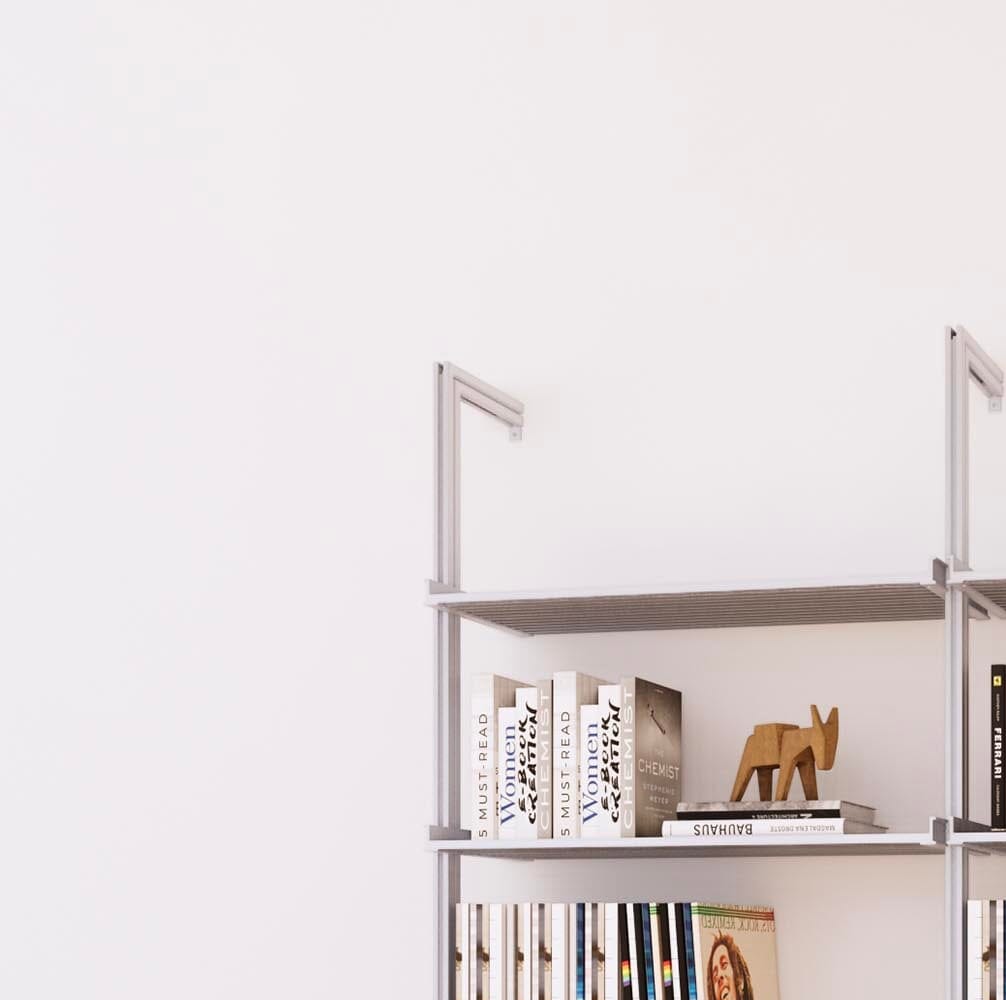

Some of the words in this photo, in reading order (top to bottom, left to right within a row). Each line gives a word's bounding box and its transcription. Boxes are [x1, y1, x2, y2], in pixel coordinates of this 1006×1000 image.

[479, 713, 488, 819] MUST-READ
[500, 726, 516, 825] Women
[518, 715, 528, 812] E-BOOK
[526, 701, 538, 824] CREATION
[540, 689, 550, 830] CHEMIST
[561, 711, 570, 818] MUST-READ
[582, 723, 598, 824] Women
[601, 712, 611, 811] E-BOOK
[608, 698, 621, 823] CREATION
[624, 689, 633, 829] CHEMIST
[638, 758, 680, 780] CHEMIST
[994, 727, 1002, 779] FERRARI
[693, 823, 753, 836] BAUHAUS
[795, 824, 836, 832] MAGDALENA
